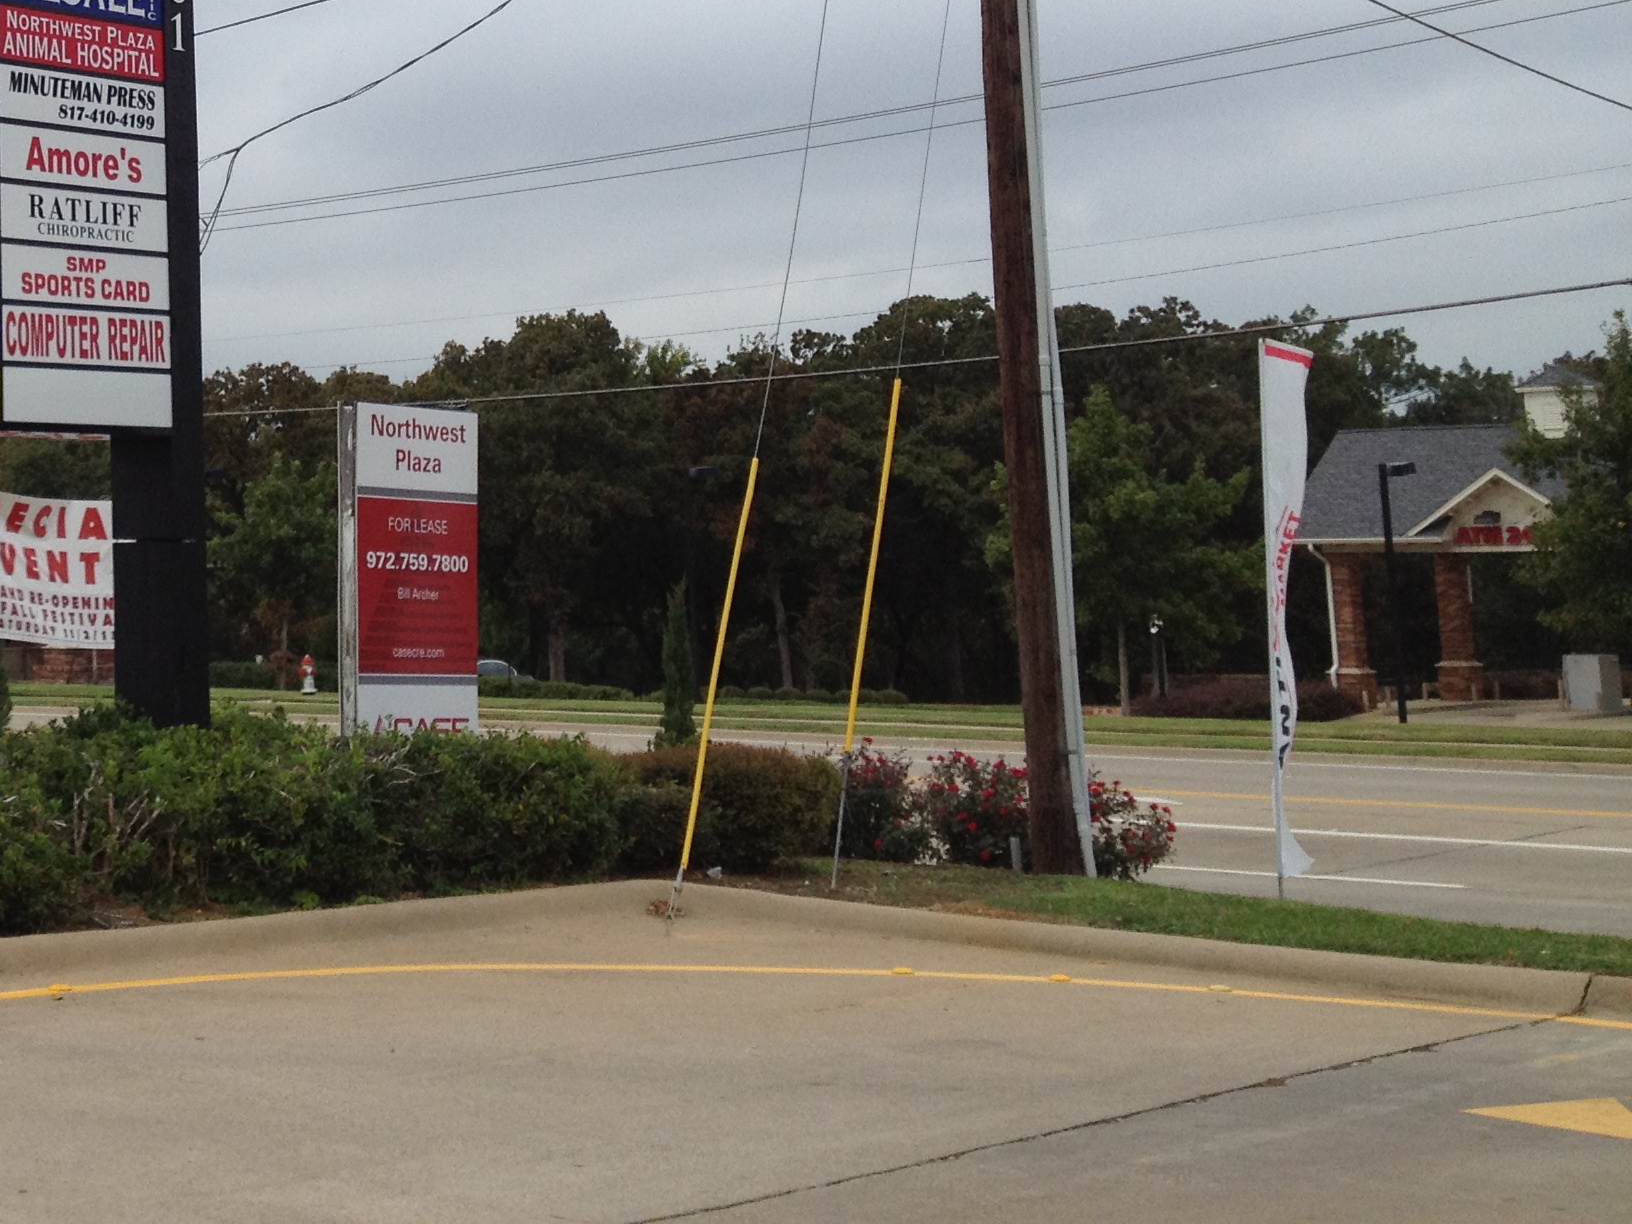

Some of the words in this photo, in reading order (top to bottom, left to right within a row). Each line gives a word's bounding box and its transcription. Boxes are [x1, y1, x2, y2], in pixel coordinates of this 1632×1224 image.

[6, 11, 101, 40] NORTHWEST
[107, 27, 155, 51] PLAZA
[4, 33, 71, 63] ANIMAL
[77, 44, 159, 77] HOSPITAL
[9, 71, 102, 101] MINUTEMAN
[107, 86, 156, 111] PRESS
[58, 105, 155, 130] 817-410-4199
[26, 137, 142, 183] Amore's
[28, 194, 142, 227] RATLIFF
[38, 223, 135, 243] CHIROPRACTIC
[66, 256, 106, 273] SMP
[21, 273, 95, 299] SPORTS
[101, 279, 150, 302] CARD
[6, 311, 100, 359] COMPUTER
[108, 318, 165, 363] REPAIR
[371, 414, 466, 443] Northwest
[396, 449, 442, 473] Plaza
[388, 517, 411, 532] FOR
[414, 518, 448, 534] LEASE
[366, 551, 468, 573] 972.759.7800
[29, 591, 114, 610] RE-OPENIN
[41, 609, 114, 626] FESTIVA
